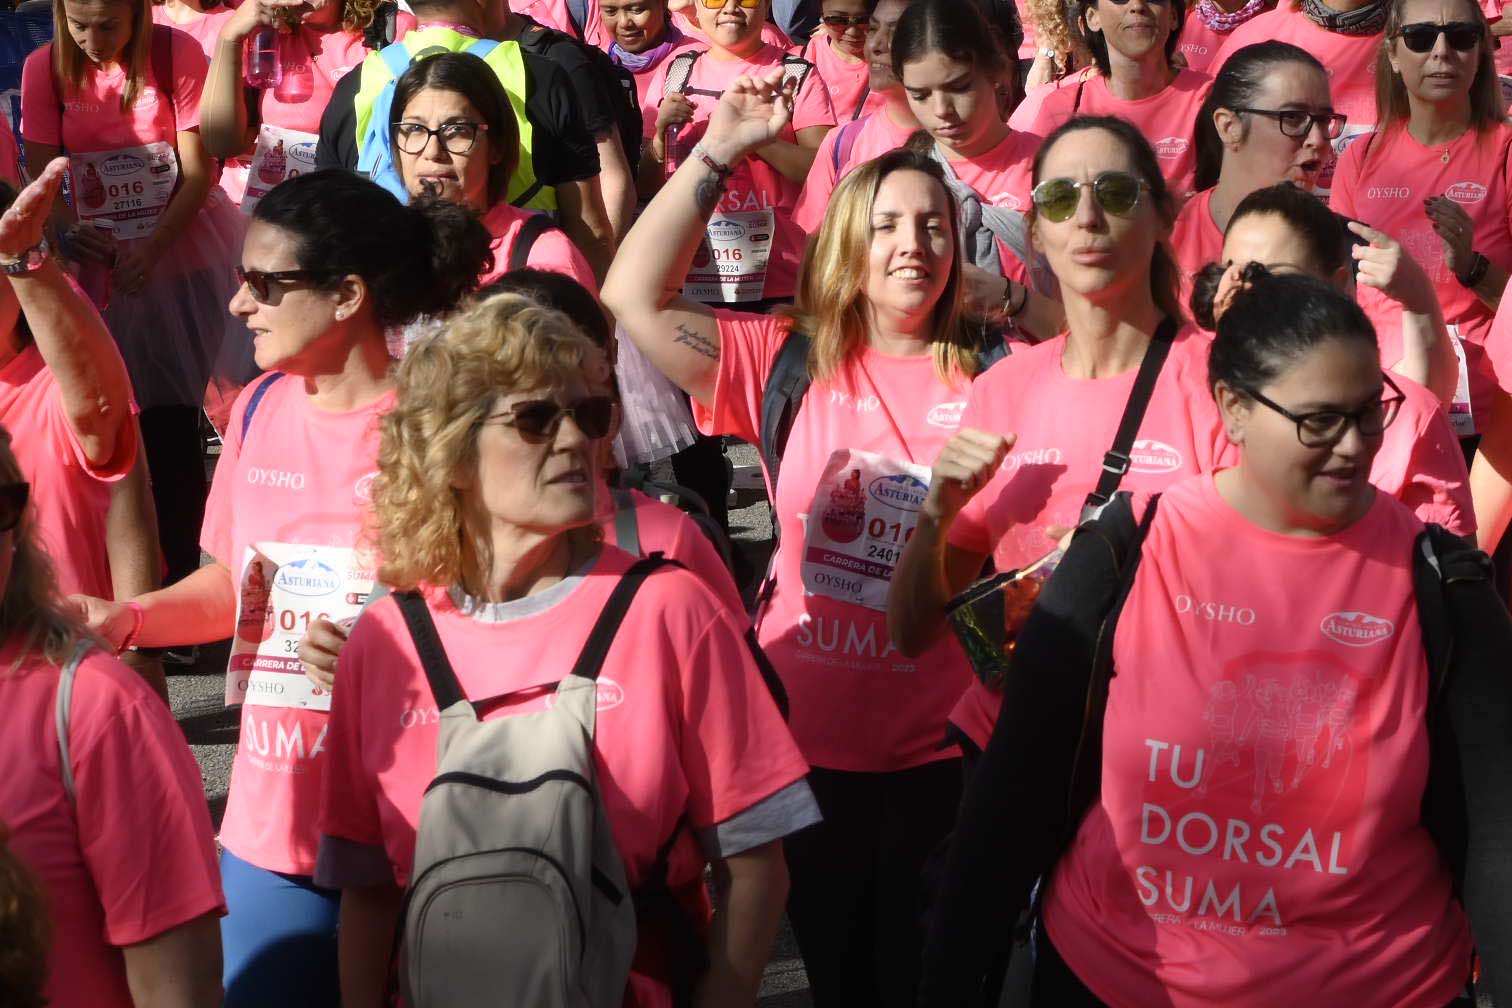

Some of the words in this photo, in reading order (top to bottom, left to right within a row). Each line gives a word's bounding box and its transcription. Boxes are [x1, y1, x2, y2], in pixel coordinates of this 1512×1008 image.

[103, 161, 144, 173] ASTURIANA
[109, 181, 144, 198] 016
[1367, 187, 1410, 200] OYSHO
[114, 198, 142, 210] 27116
[712, 249, 743, 261] 016
[1001, 448, 1061, 472] OYSHO
[246, 467, 305, 489] OYSHO
[867, 544, 900, 562] 2401
[823, 553, 867, 573] CARRERA
[277, 571, 337, 589] ASTURIANA
[814, 572, 862, 593] OYSHO
[1175, 594, 1257, 626] OYSHO
[1325, 619, 1390, 640] ASTURIANA
[284, 639, 300, 653] 32
[243, 657, 284, 671] CARRERA
[286, 660, 300, 671] DE
[237, 679, 284, 695] OYSHO
[1145, 738, 1205, 789] TU
[1140, 803, 1348, 875] DORSAL
[1136, 865, 1282, 926] SUMA
[1259, 926, 1287, 937] 2023
